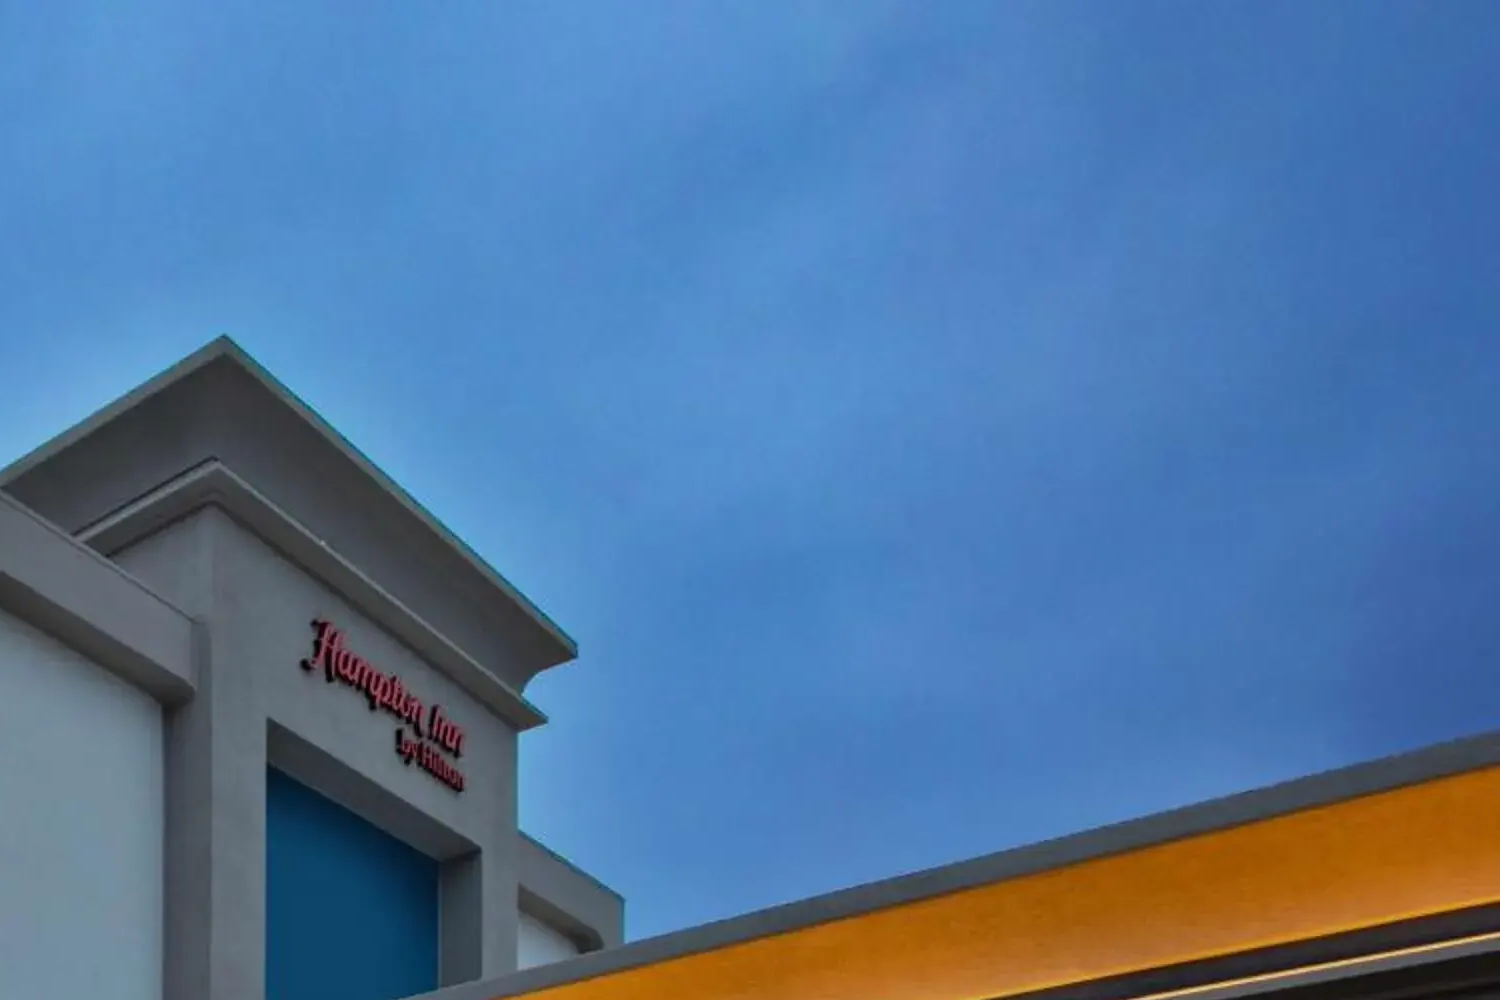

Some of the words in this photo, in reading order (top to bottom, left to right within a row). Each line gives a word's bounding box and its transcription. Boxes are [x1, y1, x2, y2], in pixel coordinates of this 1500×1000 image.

[301, 619, 426, 738] Hampton
[428, 704, 465, 758] Inn
[395, 729, 418, 767] by
